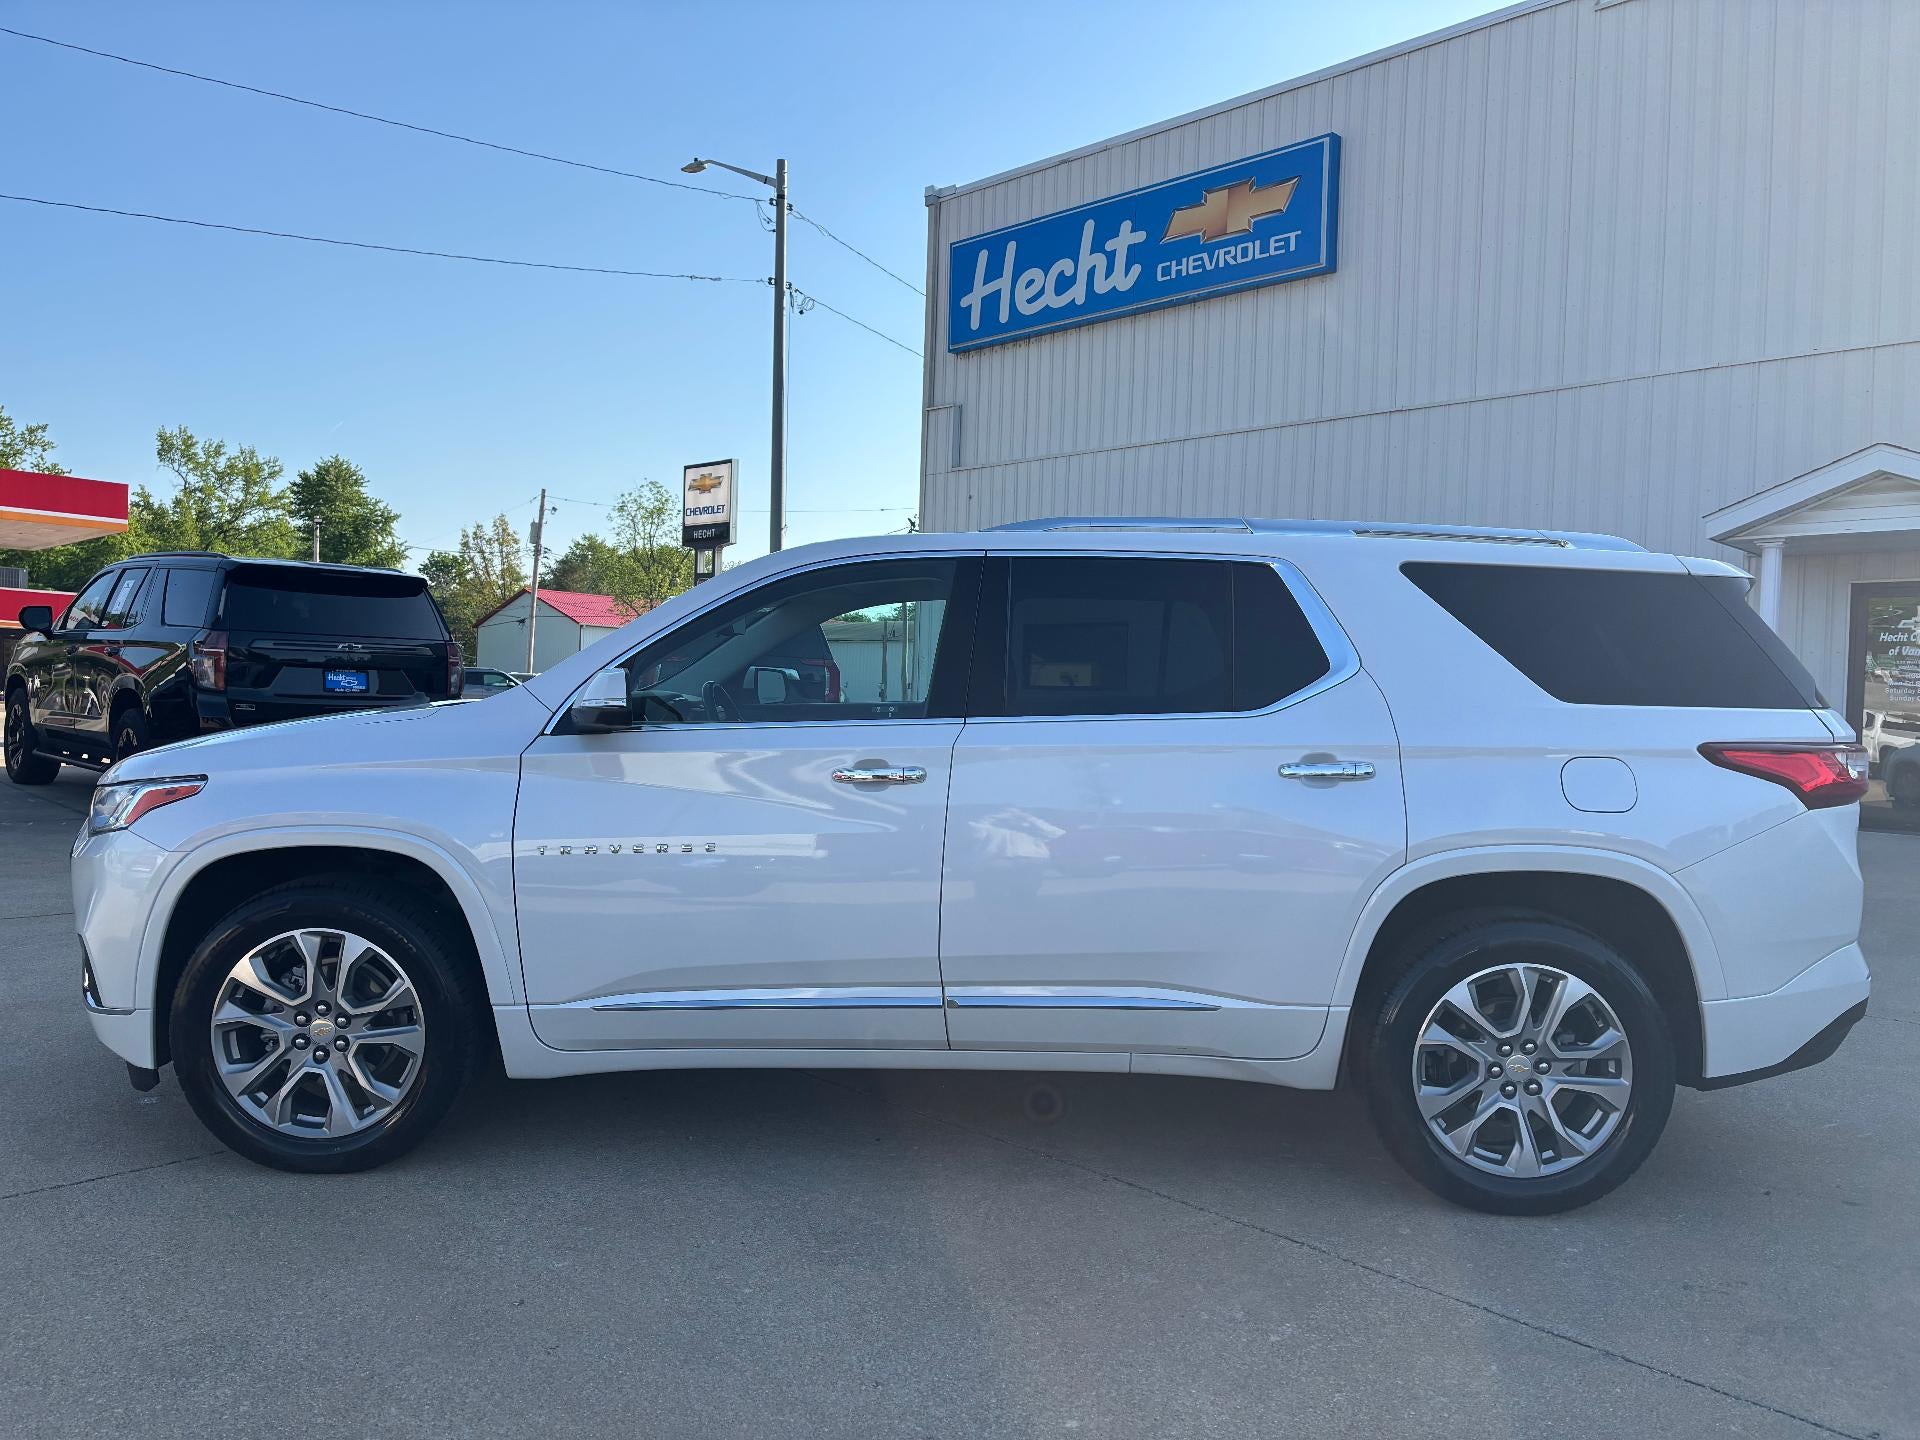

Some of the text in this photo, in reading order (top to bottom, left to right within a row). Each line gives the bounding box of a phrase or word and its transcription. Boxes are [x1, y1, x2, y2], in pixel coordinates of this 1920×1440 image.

[1157, 230, 1302, 282] CHEVROLET
[960, 219, 1146, 331] Hecht
[686, 504, 725, 517] CHEVROLET
[693, 529, 715, 539] HECHT
[1880, 632, 1908, 642] Hecht
[1889, 646, 1900, 656] of
[537, 842, 716, 855] TRAVERSE
